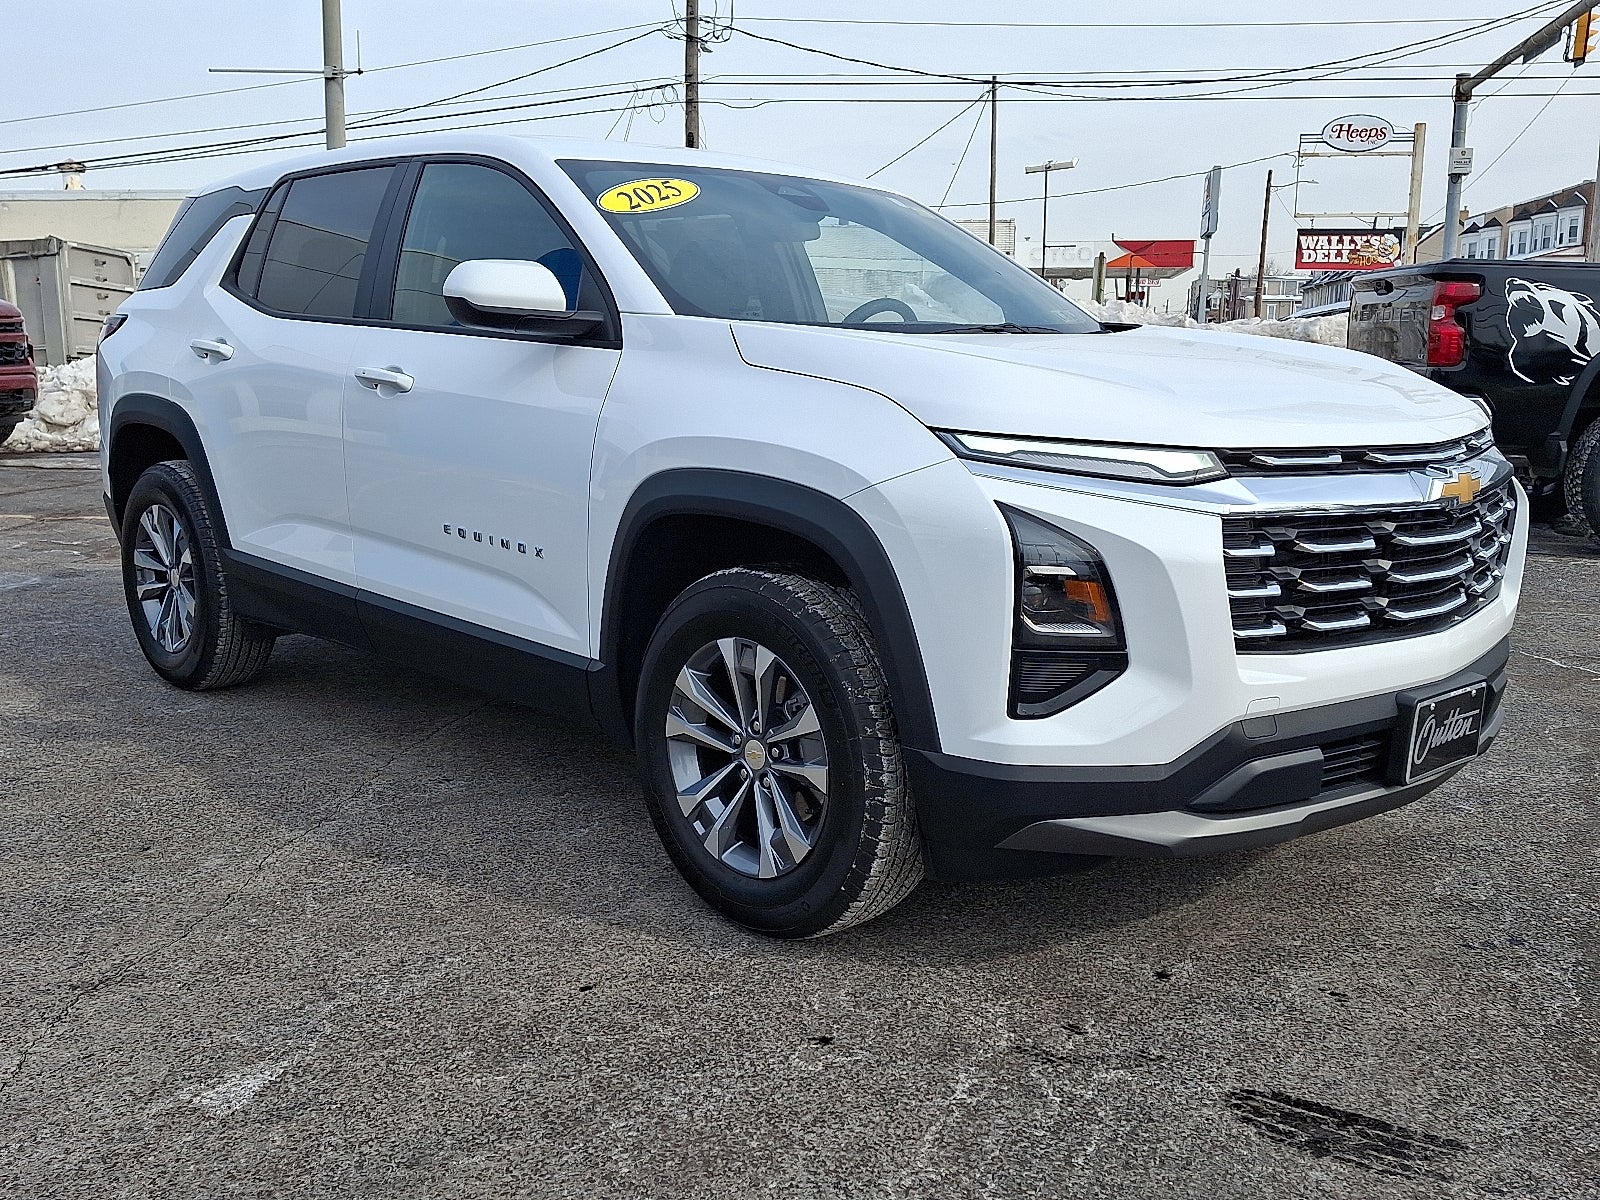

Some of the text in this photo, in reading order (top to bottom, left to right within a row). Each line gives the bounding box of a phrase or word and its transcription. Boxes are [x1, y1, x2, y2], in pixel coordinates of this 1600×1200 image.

[1331, 123, 1387, 143] Heeps
[616, 181, 682, 210] 2025
[1300, 234, 1381, 250] WALLY'S
[1029, 247, 1093, 261] CTGO
[1301, 249, 1350, 263] DELI
[443, 524, 544, 559] EQUINOX
[1413, 707, 1480, 765] Outten
